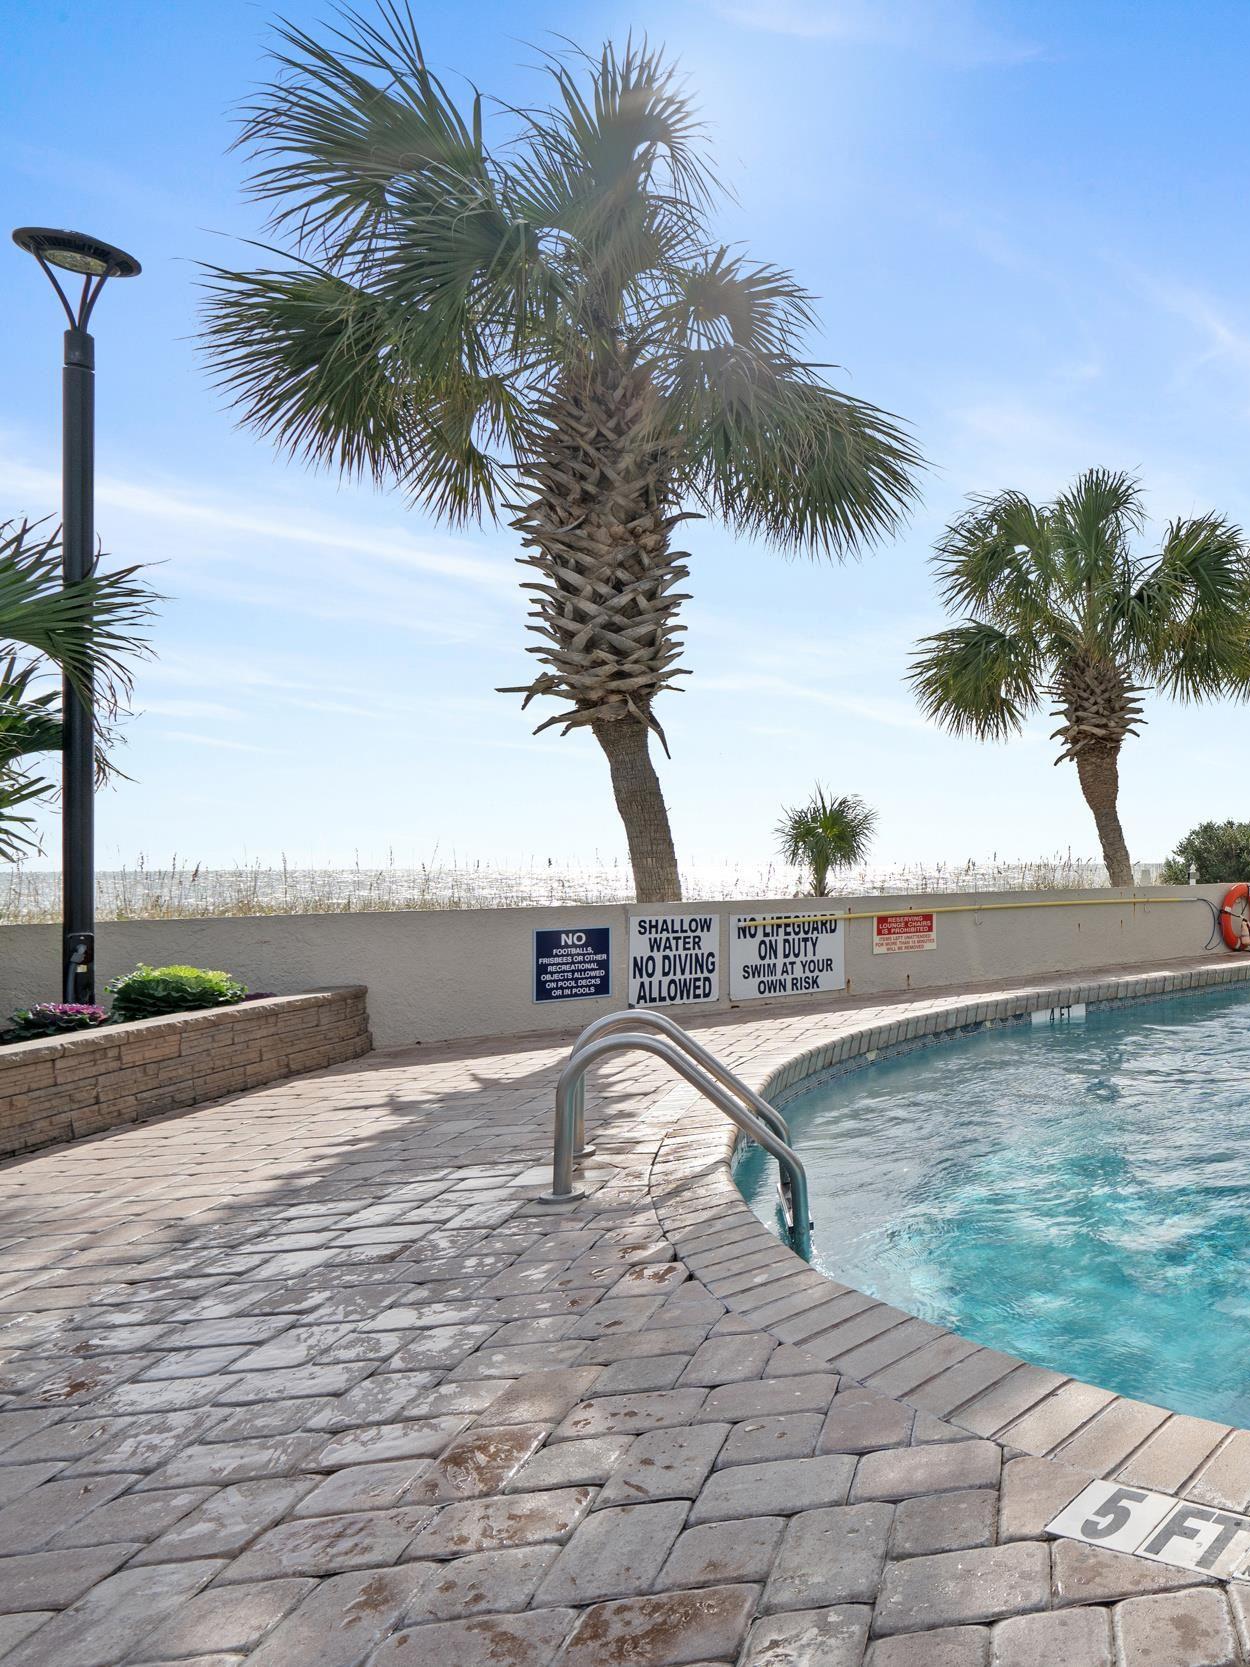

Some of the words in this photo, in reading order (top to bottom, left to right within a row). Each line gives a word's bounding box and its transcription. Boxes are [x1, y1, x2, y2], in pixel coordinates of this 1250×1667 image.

[638, 918, 712, 936] SHALLOW
[738, 917, 758, 940] NO
[762, 914, 837, 938] LIFEGUARD
[561, 932, 586, 946] NO
[648, 935, 702, 952] WATER
[552, 946, 594, 956] FOOTBALLS,
[758, 939, 778, 961] ON
[783, 936, 818, 959] DUTY
[538, 956, 572, 964] FRISBEES
[584, 954, 607, 962] OTHER
[548, 962, 598, 972] RECREATIONAL
[632, 955, 656, 980] NO
[662, 952, 716, 978] DIVING
[540, 972, 572, 981] OBJECTS
[574, 970, 606, 978] ALLOWED
[742, 962, 776, 980] SWIM
[781, 961, 796, 976] AT
[800, 958, 834, 974] YOUR
[636, 976, 712, 1004] ALLOWED
[758, 978, 786, 995] OWN
[792, 975, 820, 991] RISK
[1050, 1008, 1055, 1020] 4
[1060, 1005, 1072, 1022] FT
[1080, 1488, 1149, 1540] 5
